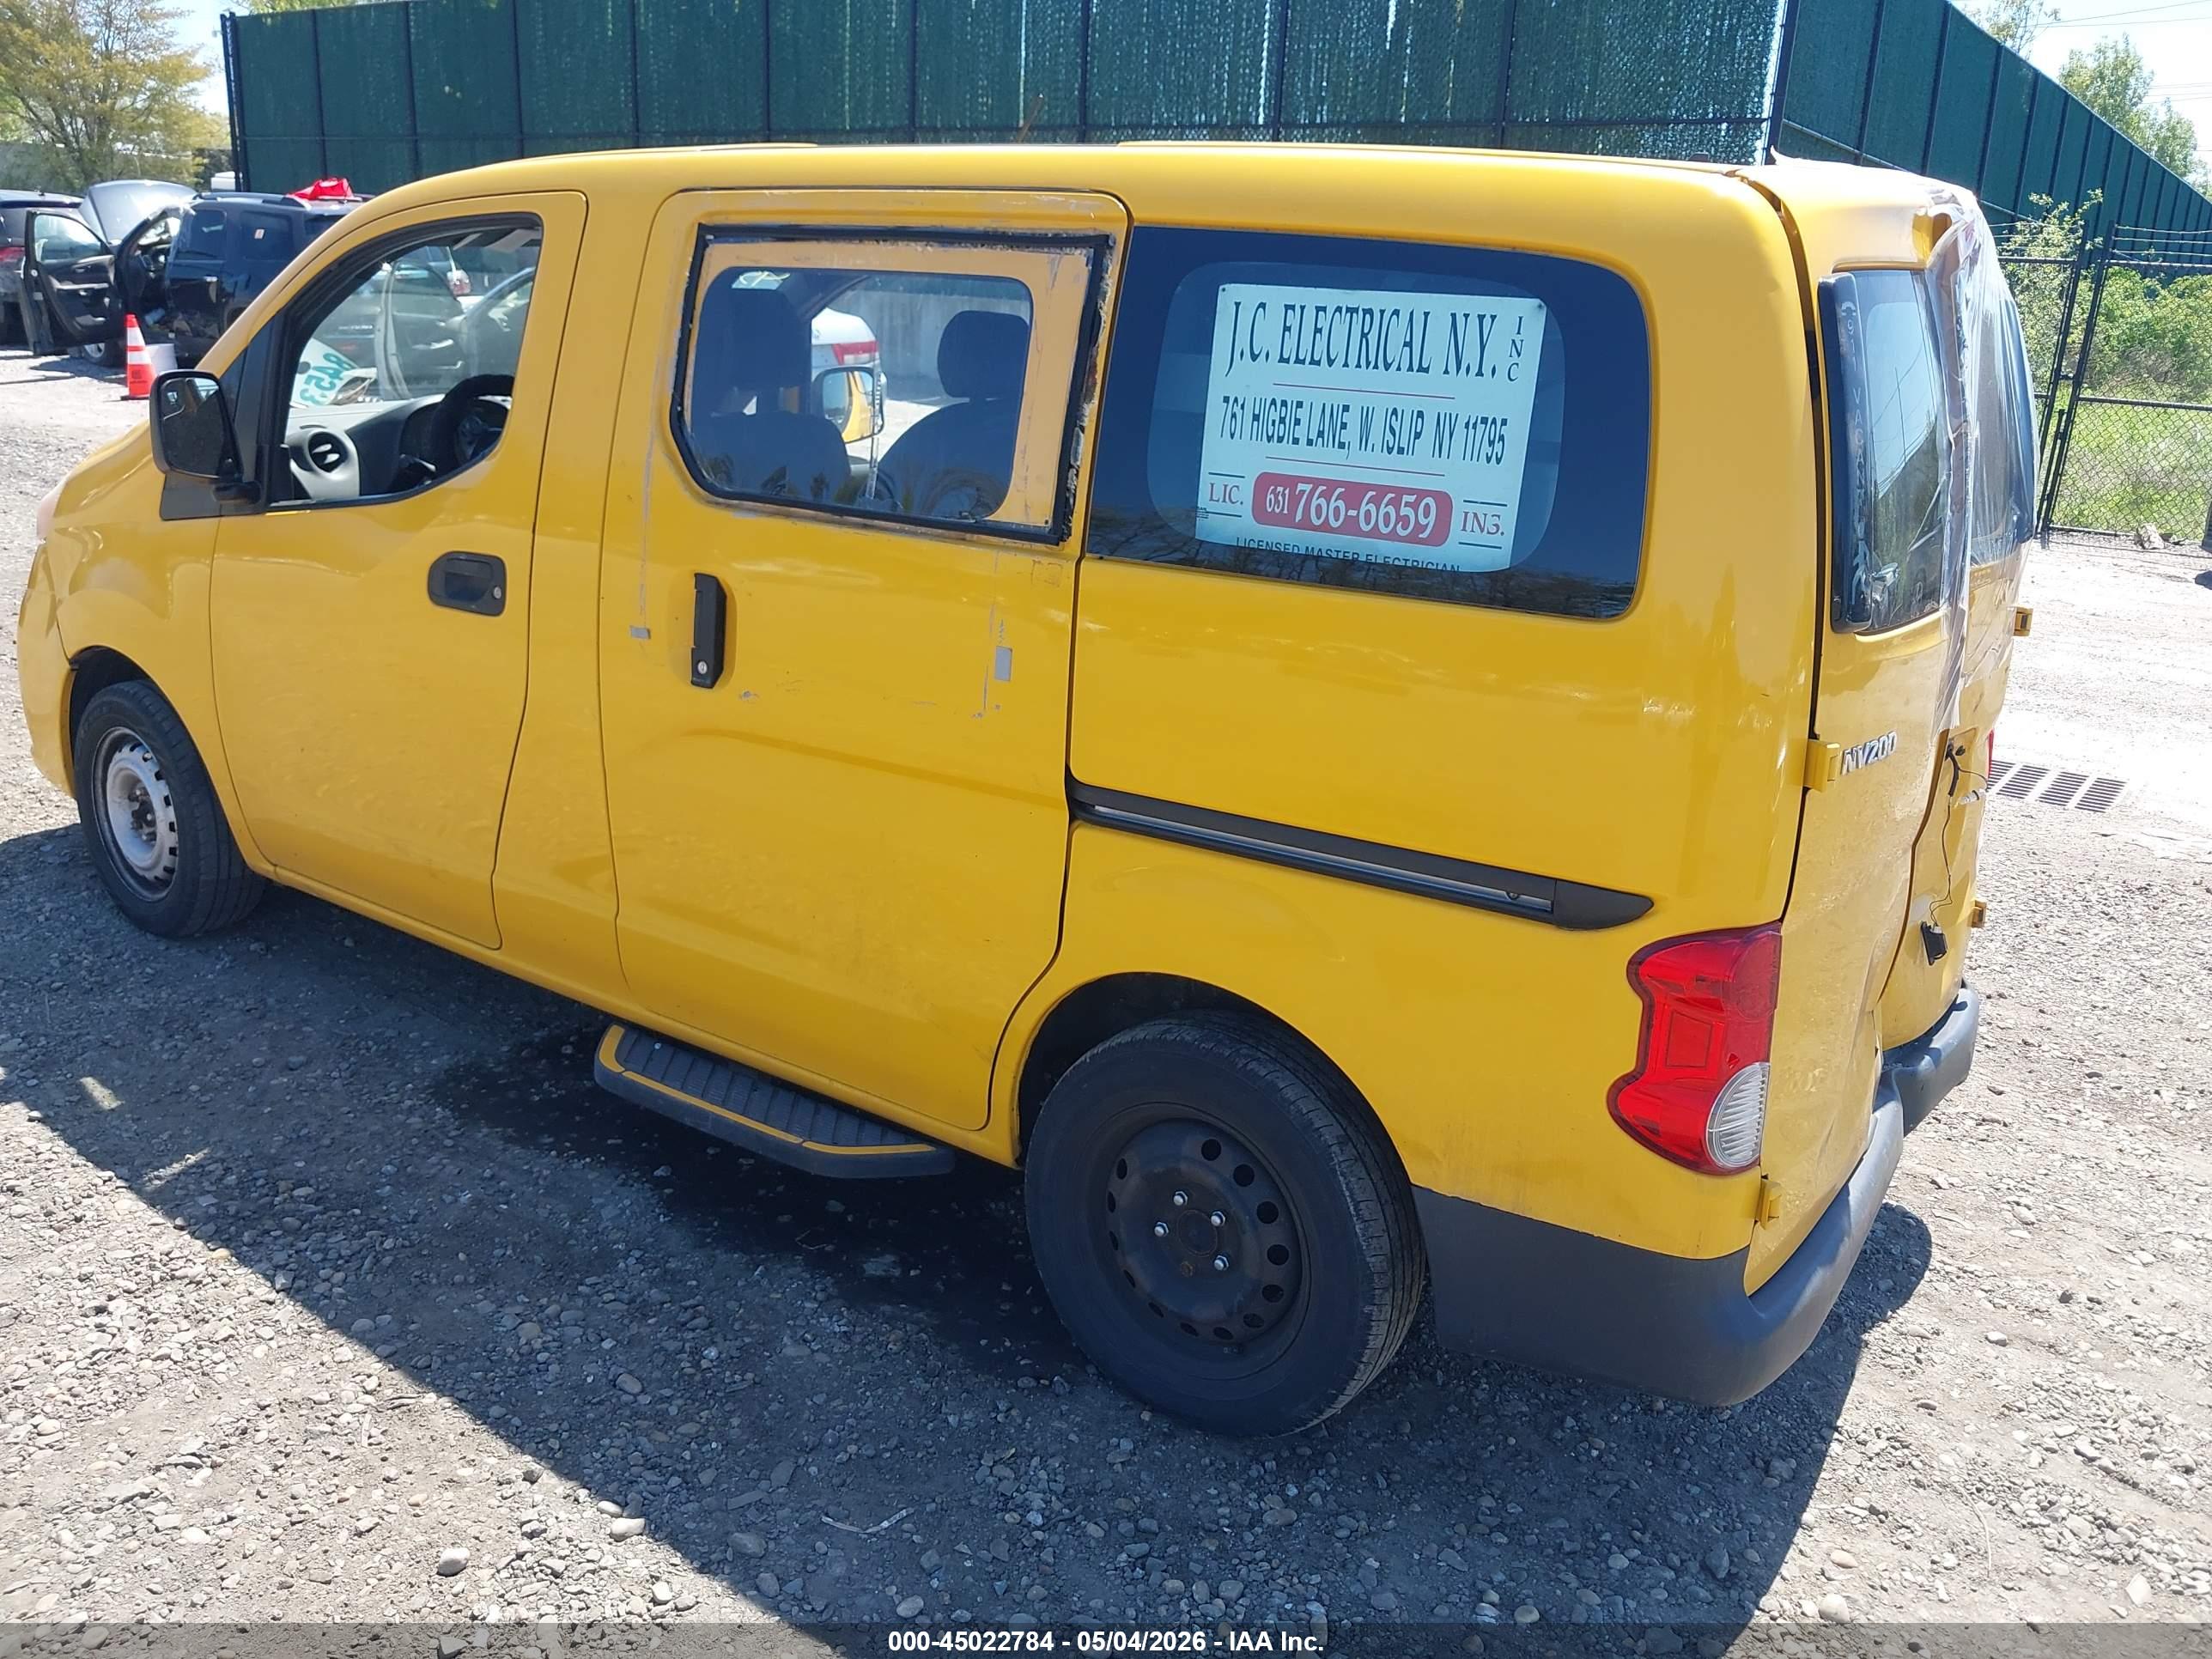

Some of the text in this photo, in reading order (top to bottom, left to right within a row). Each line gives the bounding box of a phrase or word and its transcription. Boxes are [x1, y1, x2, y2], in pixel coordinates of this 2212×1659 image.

[1224, 301, 1498, 379] J.C. ELECTRICAL N.Y.
[1507, 315, 1524, 382] INC
[1220, 395, 1508, 465] 761 HIGBIE LANE, W. ISLIP NY 11795
[1208, 482, 1243, 506] LIC.
[1266, 483, 1437, 539] 631 766-6659
[1840, 731, 1897, 775] NV200
